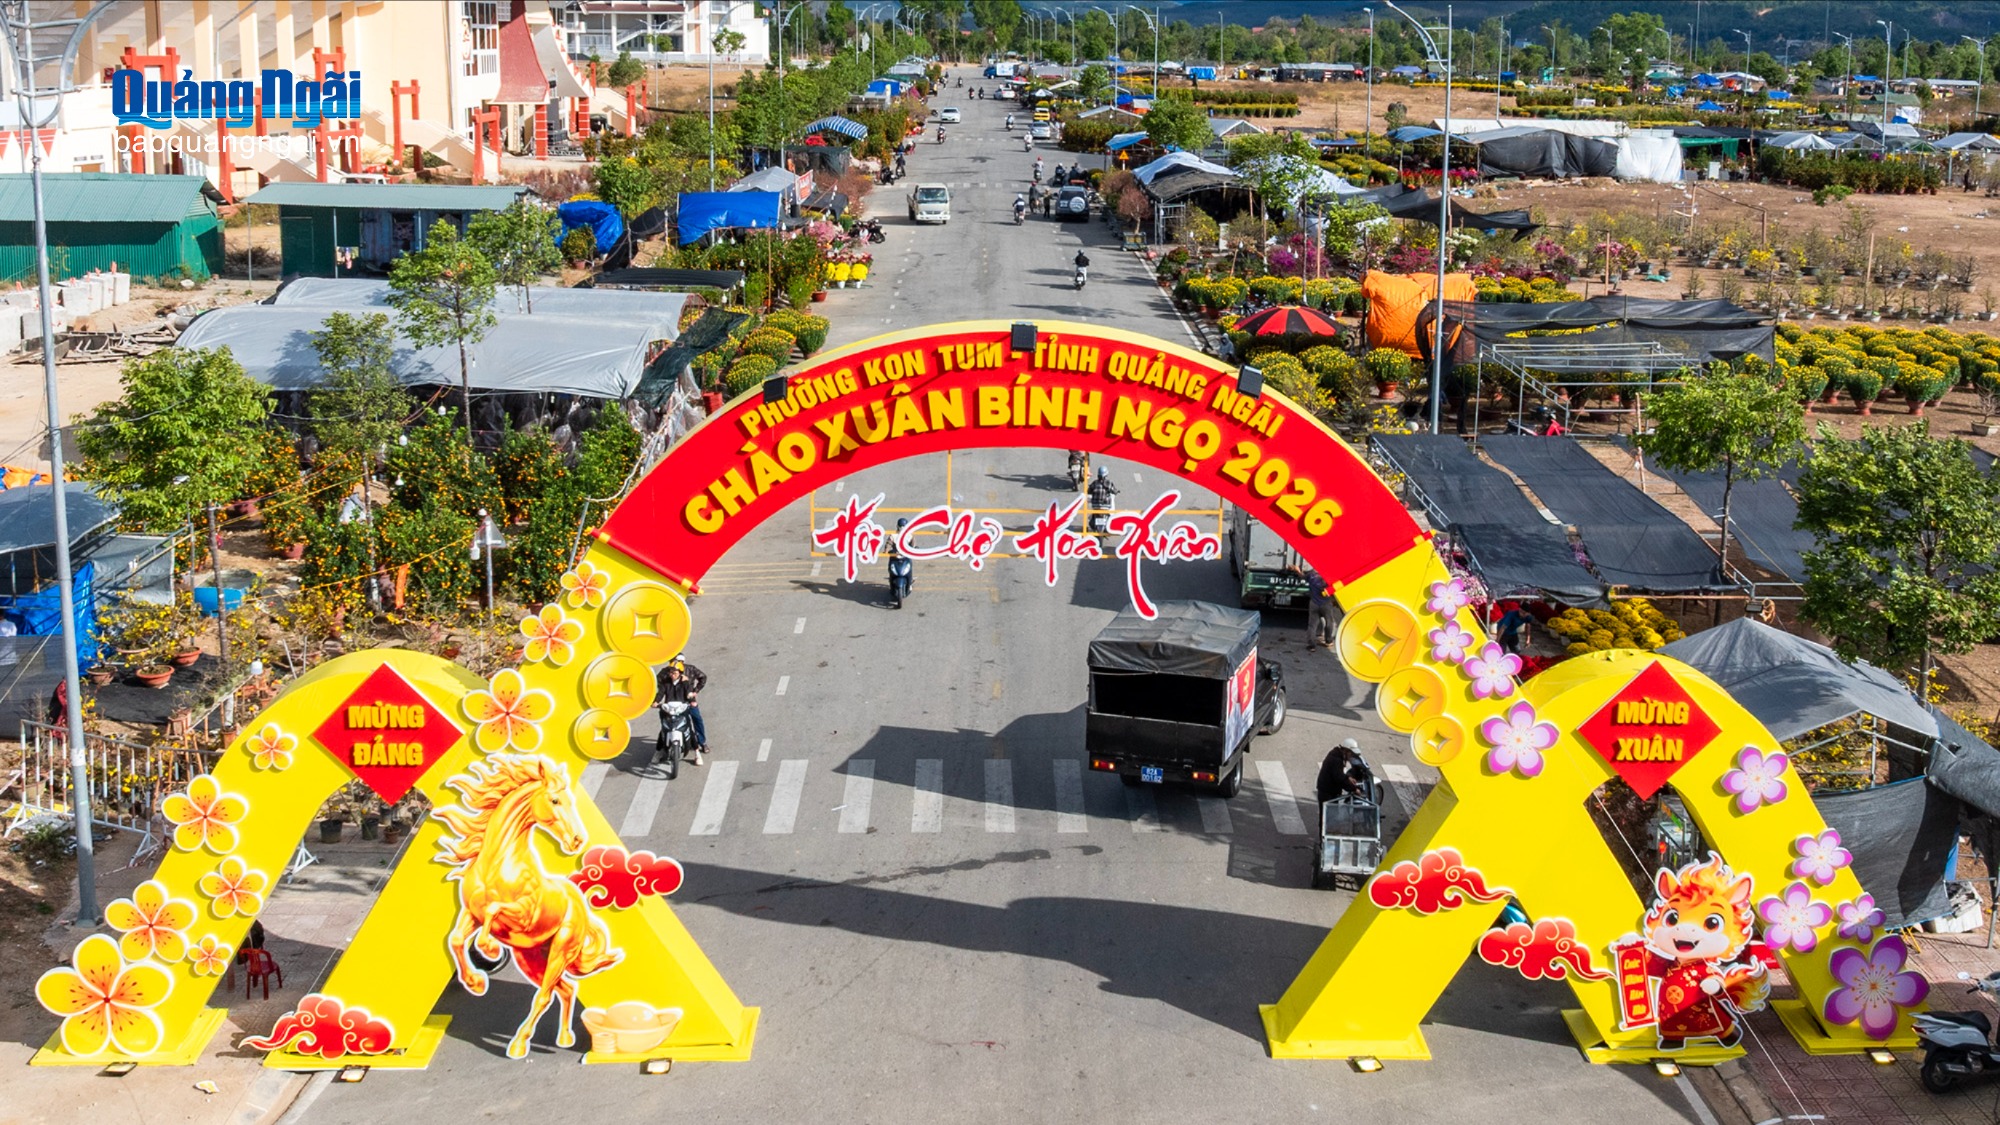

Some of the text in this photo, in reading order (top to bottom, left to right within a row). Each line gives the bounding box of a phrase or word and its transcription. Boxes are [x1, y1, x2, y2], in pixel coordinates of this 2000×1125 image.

[740, 367, 858, 437] PHƯỜNG
[863, 349, 926, 387] KON
[938, 341, 1003, 371] TUM
[1034, 334, 1099, 373] TỈNH
[1108, 351, 1209, 402] QUẢNG
[1211, 384, 1286, 439] NGÃI
[684, 372, 1344, 537] CHÀO XUÂN BÍNH NGỌ 2026
[814, 491, 1220, 619] Hội Chợ Hoa Xuân
[348, 701, 425, 728] MỪNG
[1616, 696, 1690, 725] MỪNG
[352, 734, 424, 766] ĐẢNG
[1615, 733, 1684, 762] XUÂN
